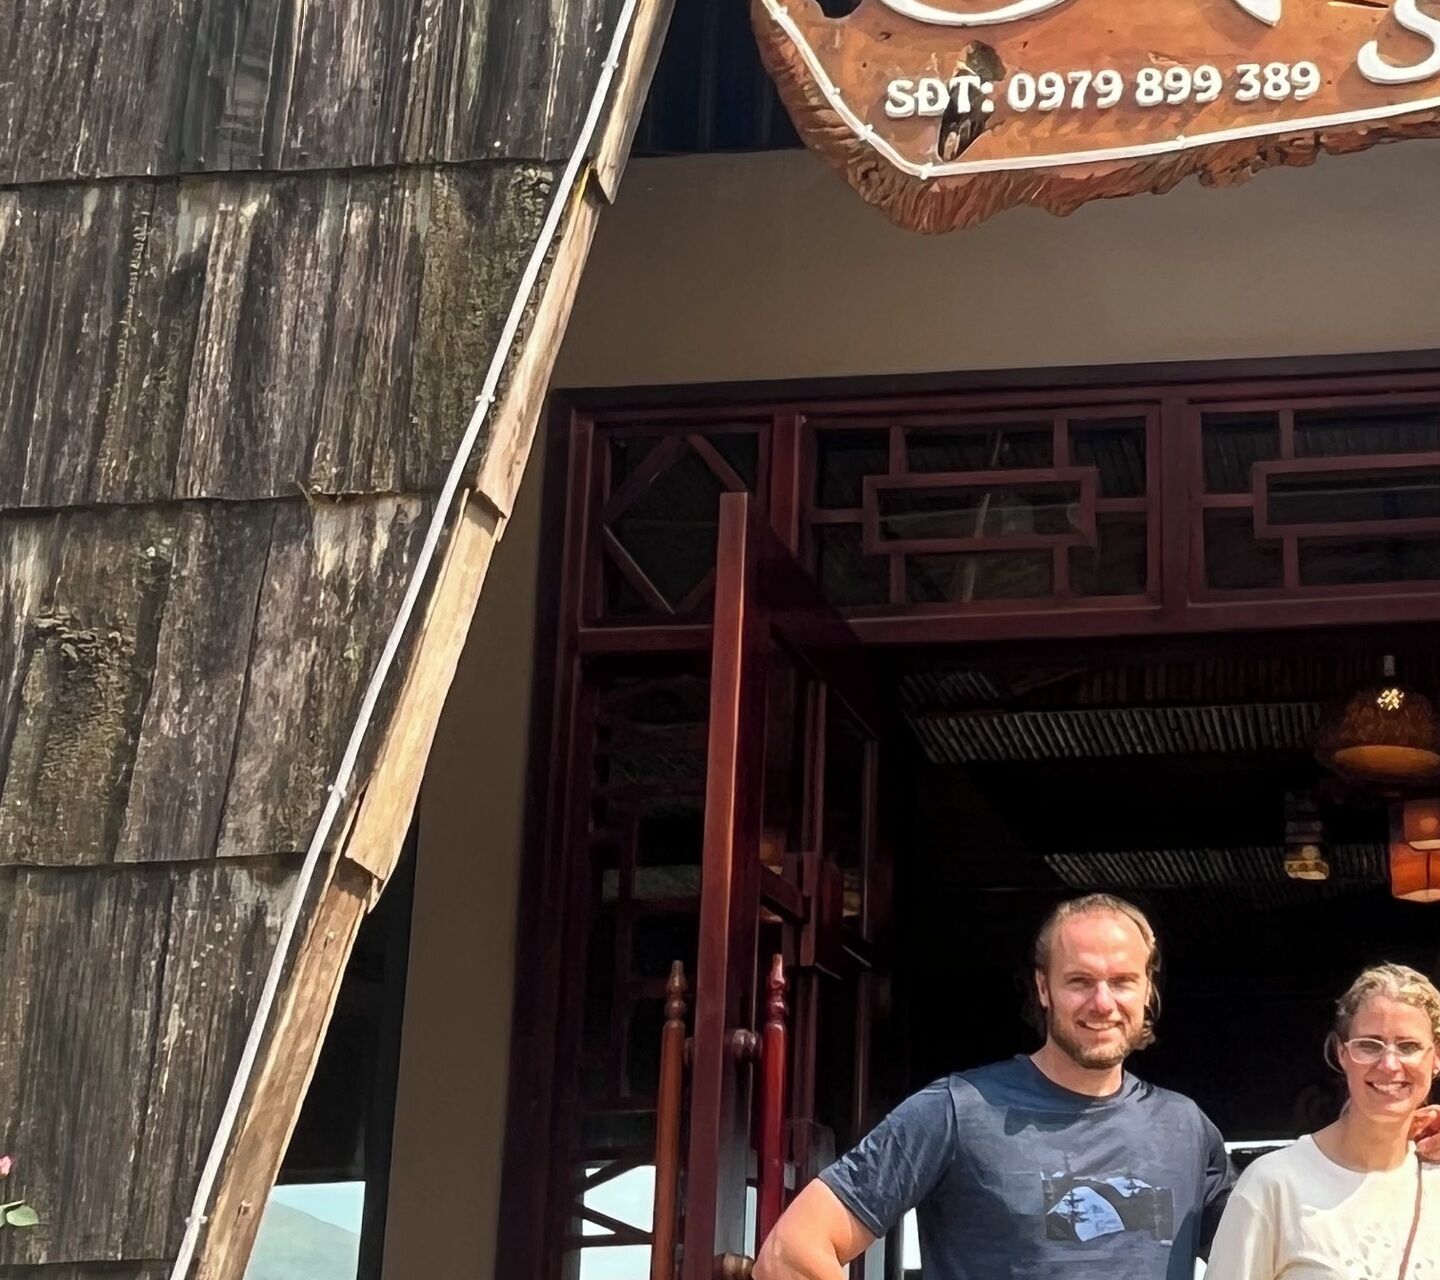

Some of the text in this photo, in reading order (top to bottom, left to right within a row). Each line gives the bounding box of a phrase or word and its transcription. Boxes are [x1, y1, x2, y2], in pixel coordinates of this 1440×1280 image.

[885, 60, 1321, 118] SĐT: 0979 899 389
